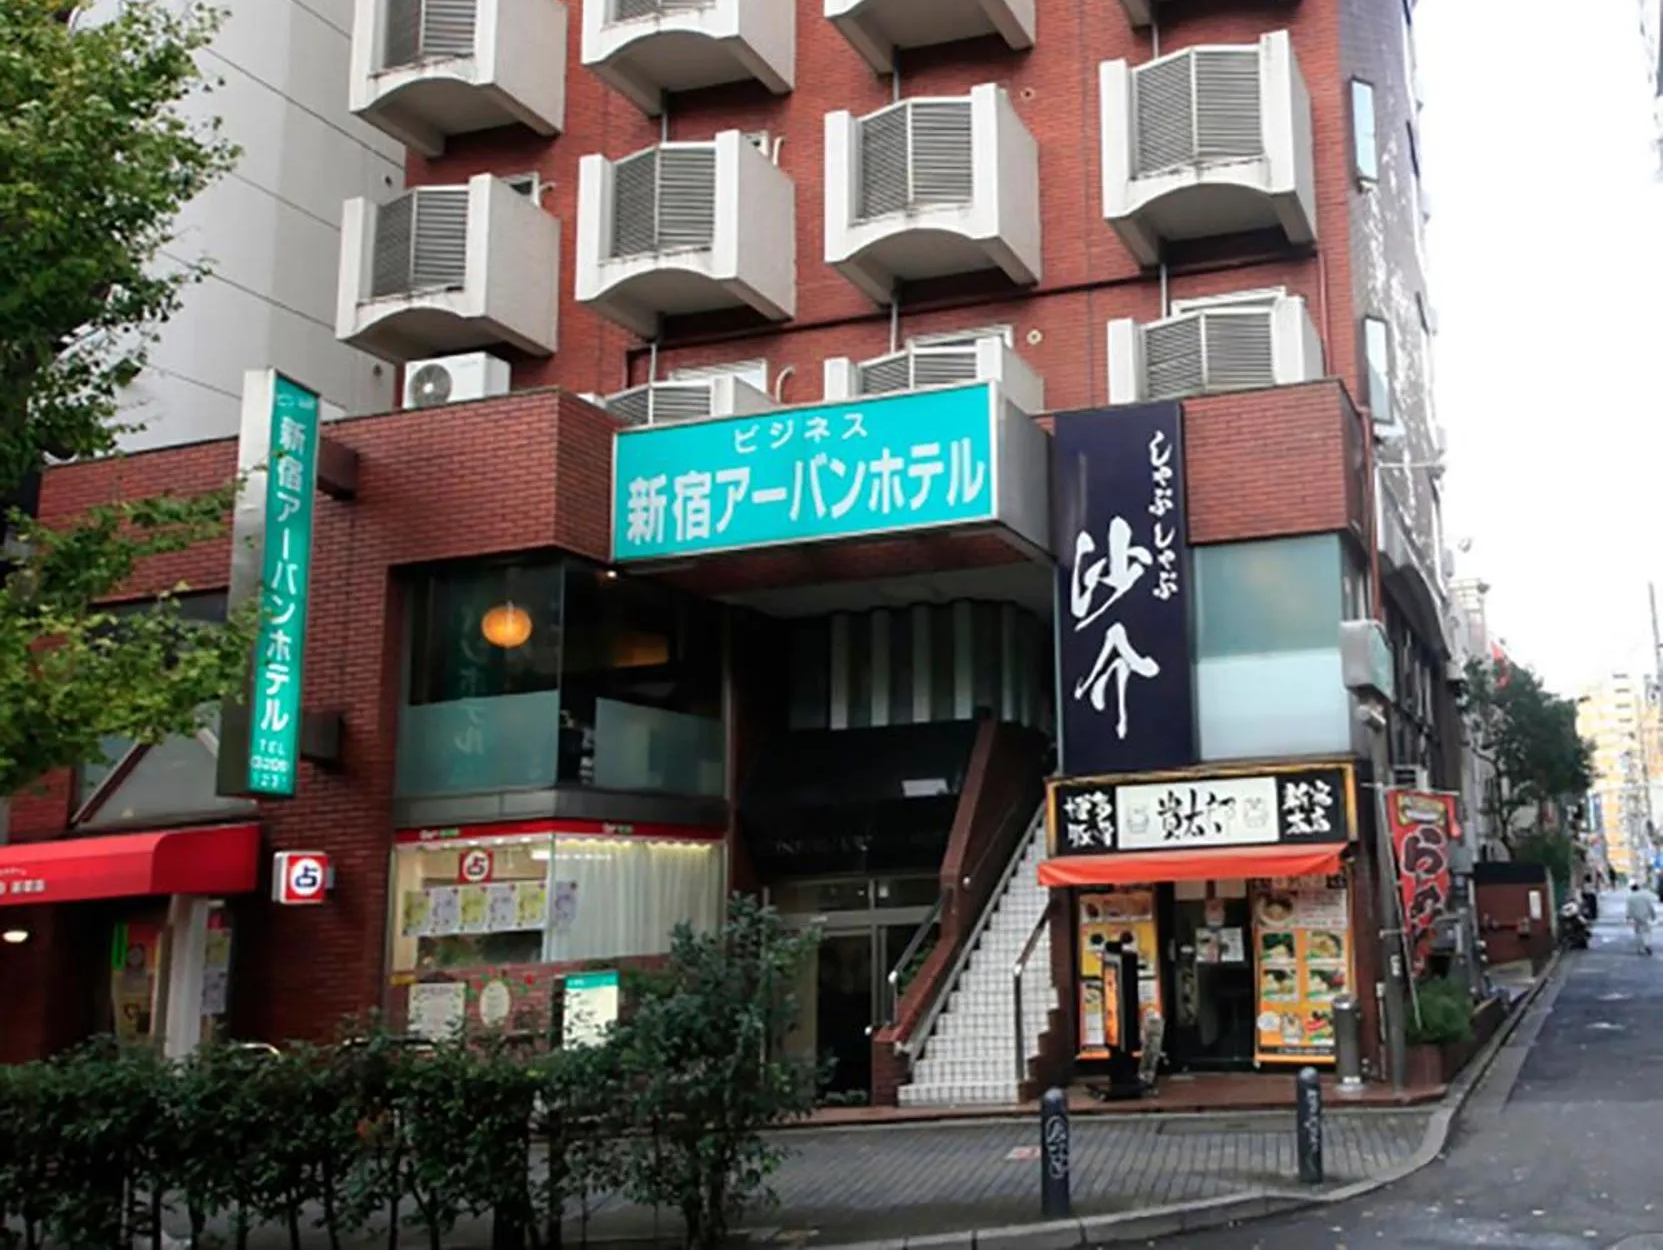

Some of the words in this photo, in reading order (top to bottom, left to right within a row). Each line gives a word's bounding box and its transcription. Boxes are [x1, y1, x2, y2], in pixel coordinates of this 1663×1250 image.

[734, 413, 868, 454] ビジネス
[627, 437, 985, 546] 新宿アーバンホテル
[1149, 430, 1178, 600] しゃぶしゃぶ
[261, 415, 306, 731] 新宿アーバンホテル
[295, 864, 318, 888] 占
[465, 855, 486, 876] 占
